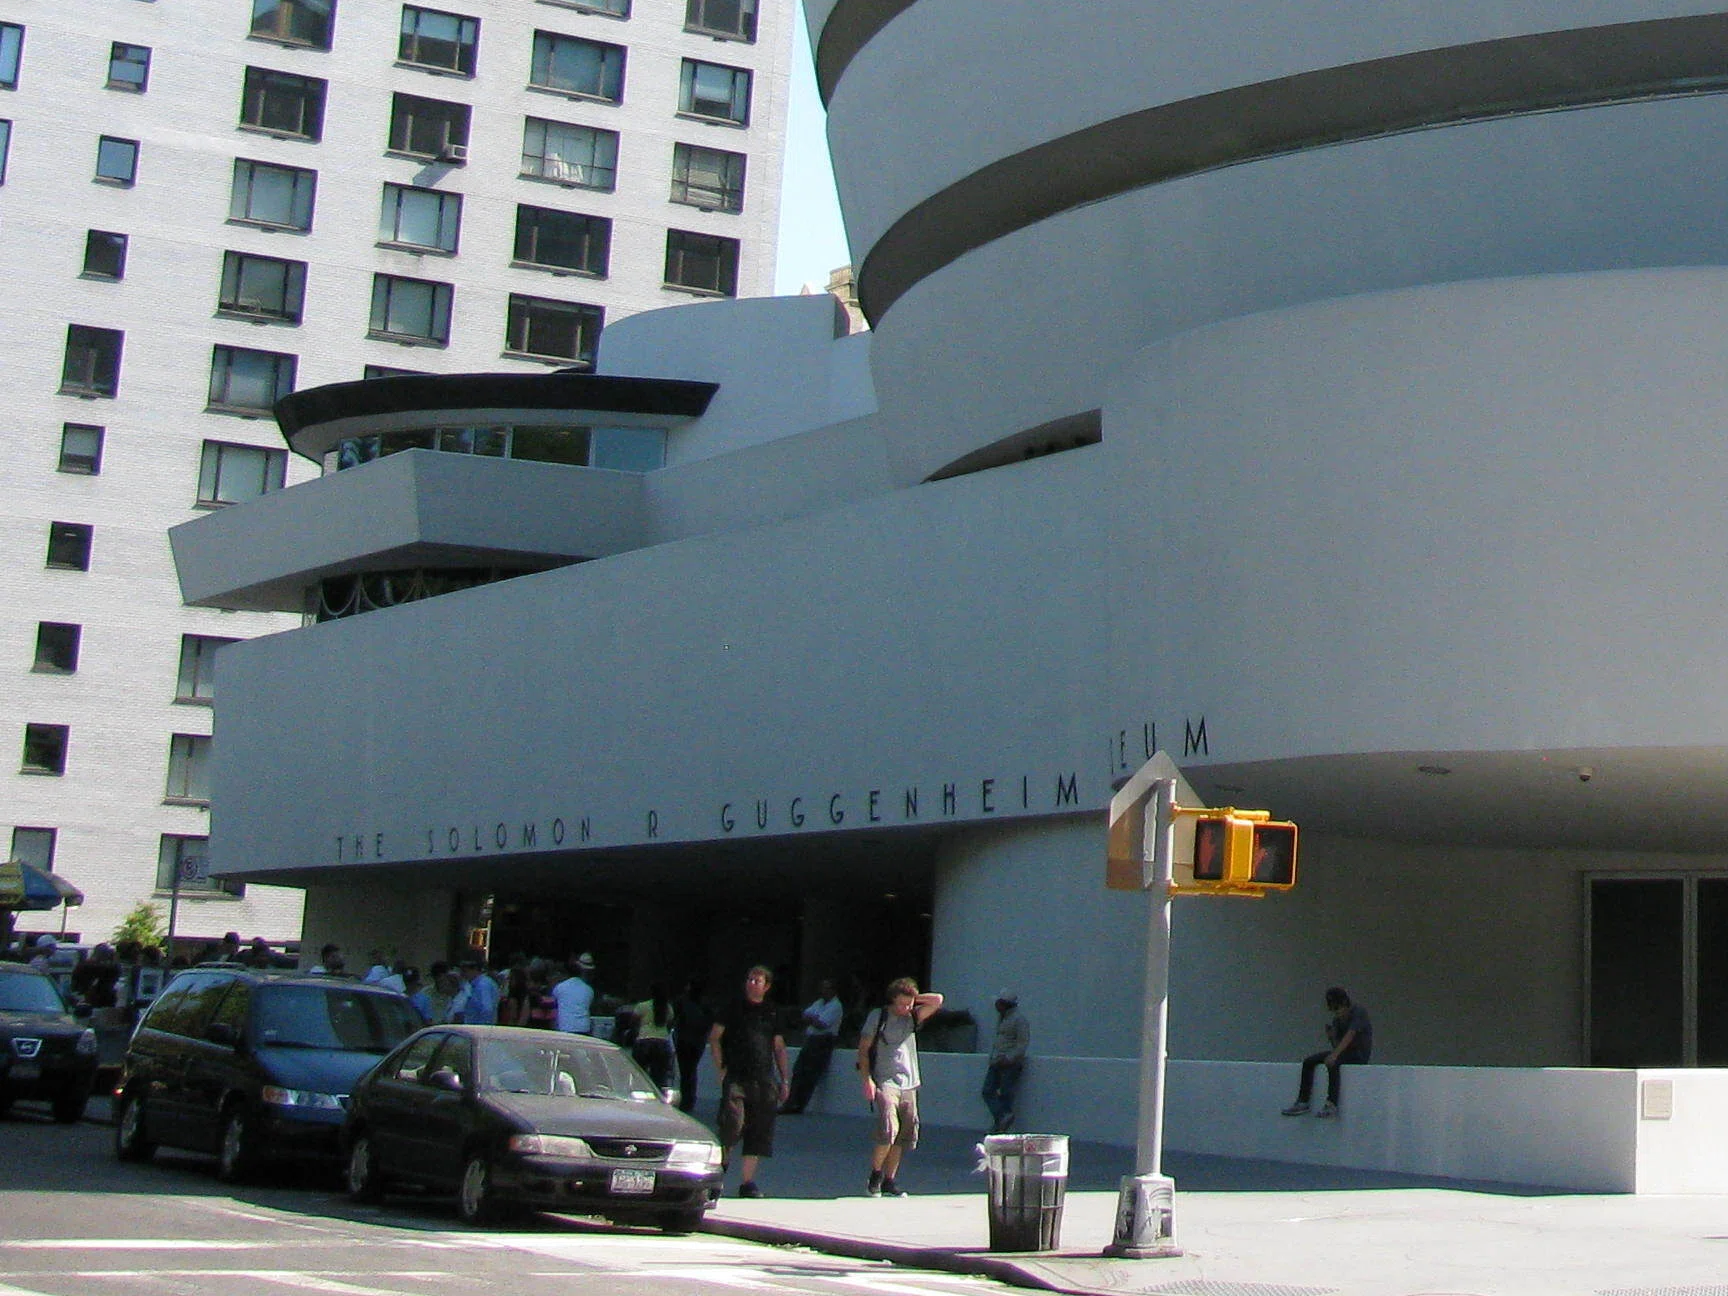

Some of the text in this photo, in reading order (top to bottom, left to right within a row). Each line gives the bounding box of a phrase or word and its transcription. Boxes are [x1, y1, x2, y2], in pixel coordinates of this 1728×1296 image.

[336, 832, 384, 860] THE
[427, 817, 591, 854] SOLOMON
[647, 809, 659, 839] R
[721, 771, 1079, 833] GUGGENHEIM
